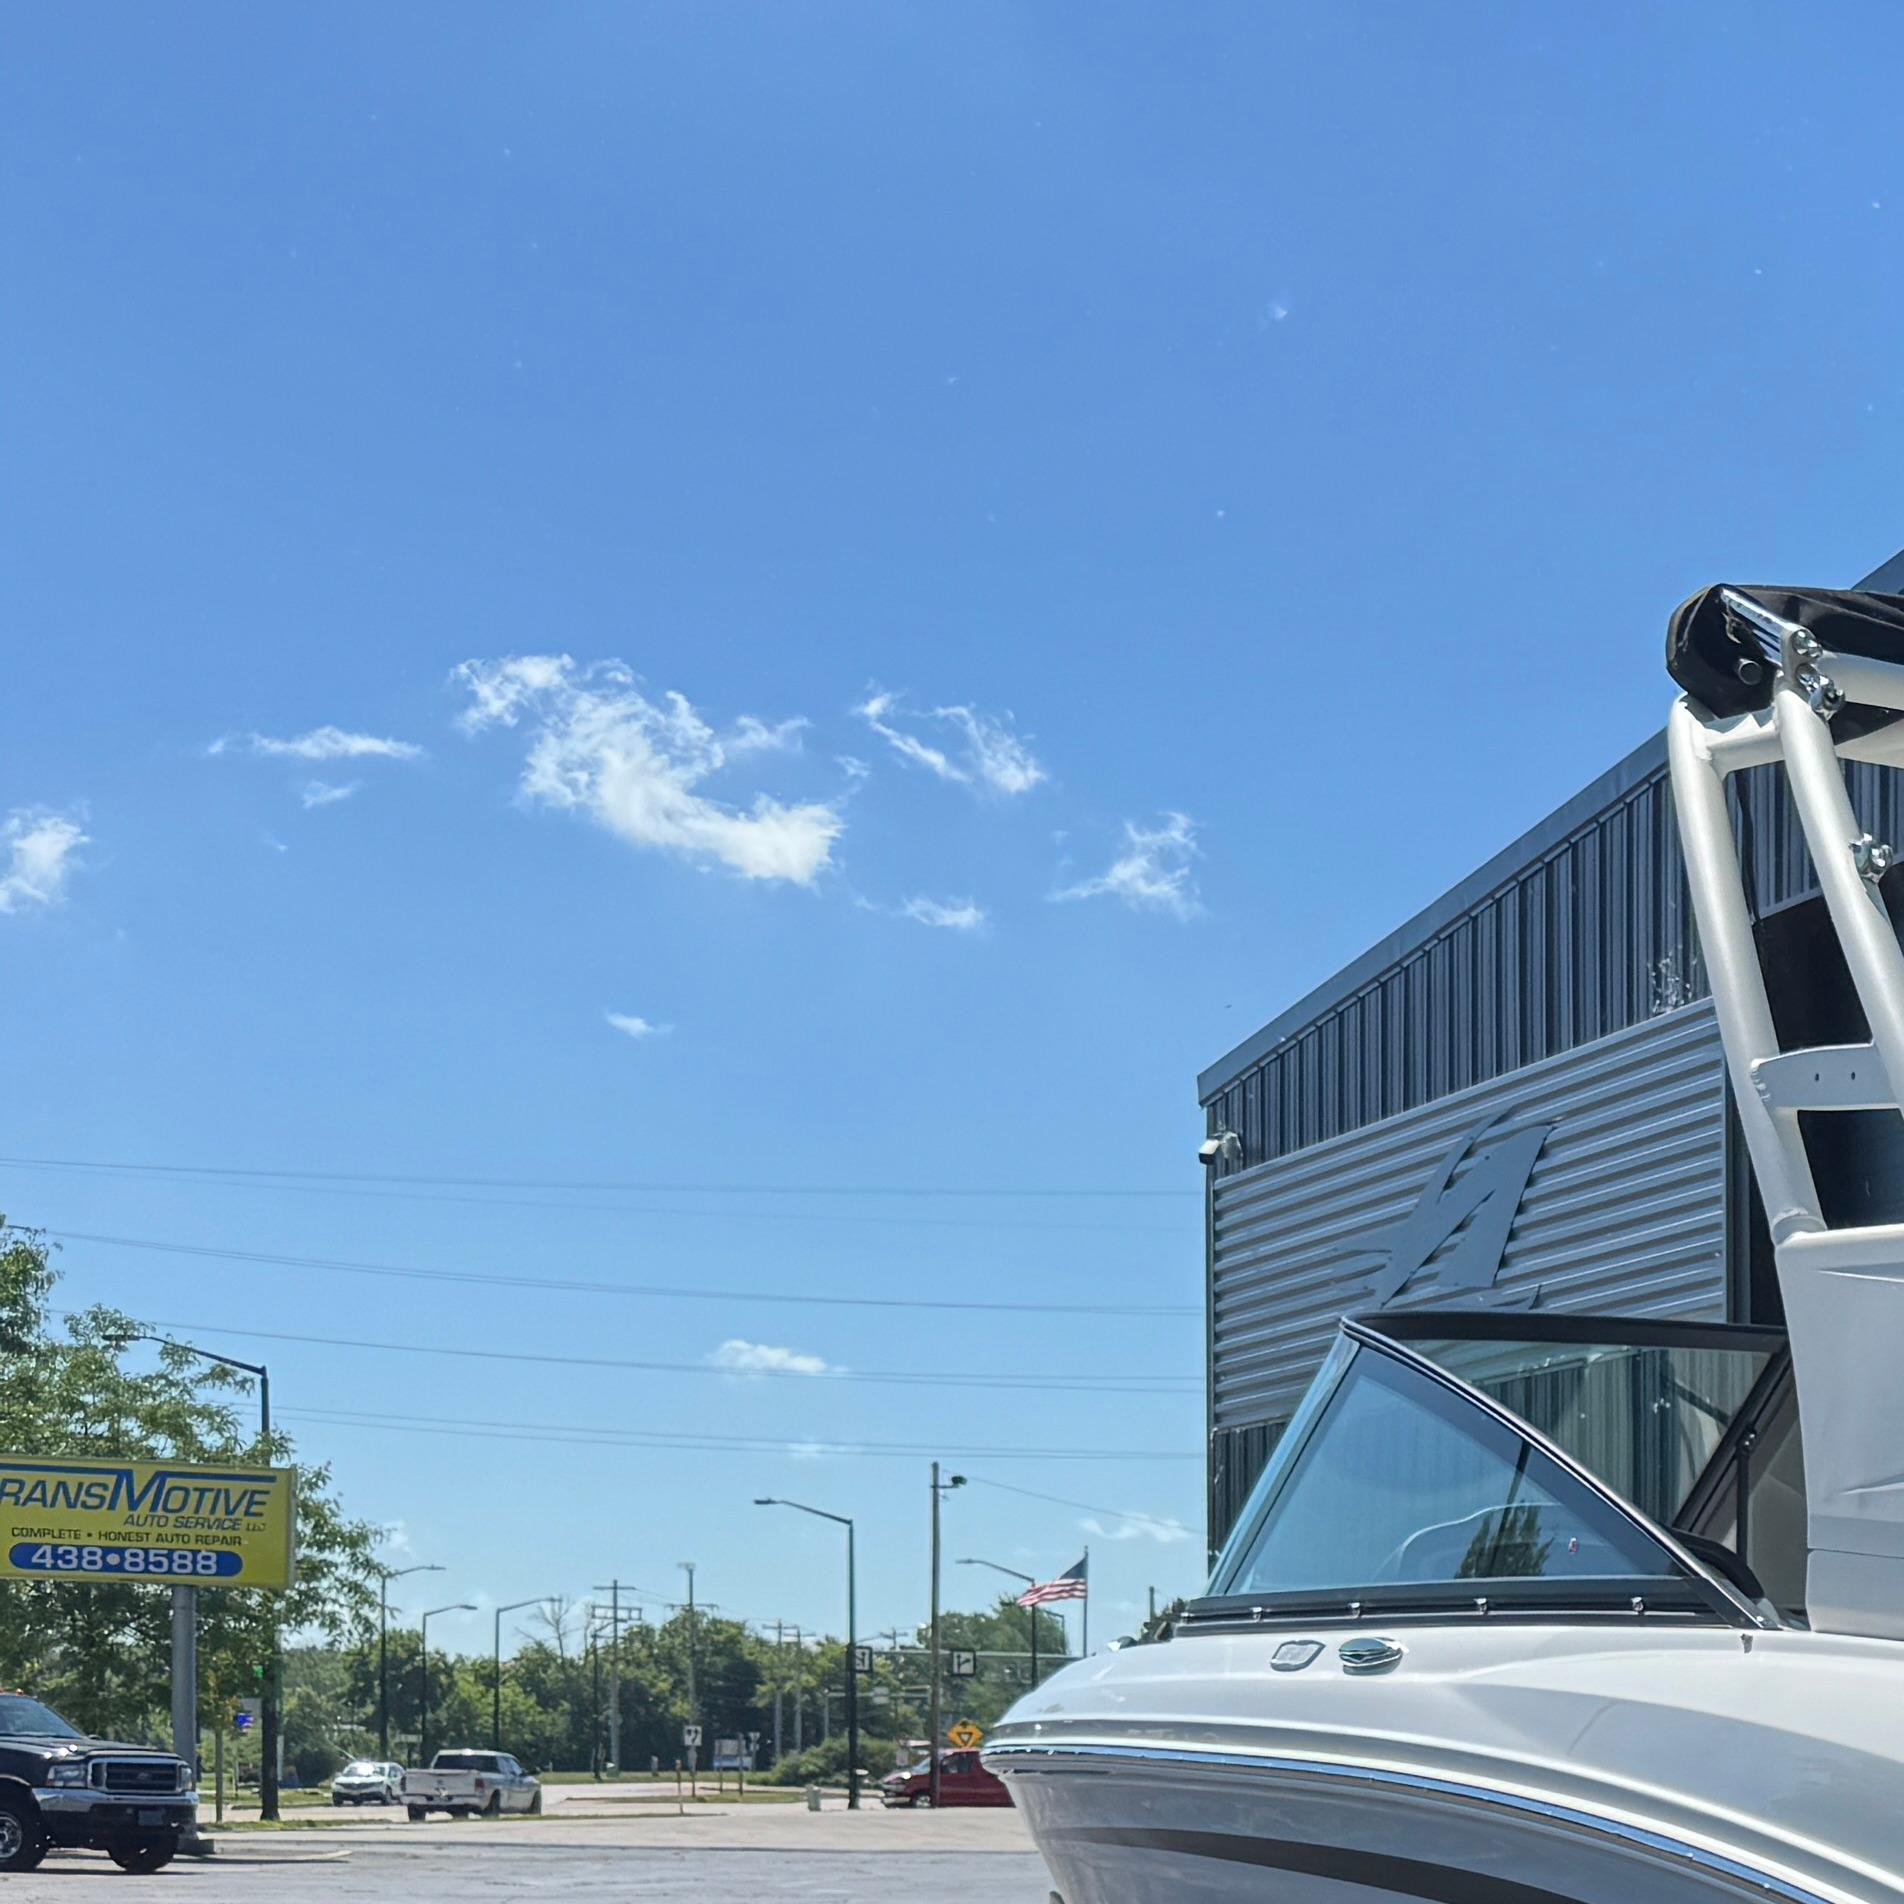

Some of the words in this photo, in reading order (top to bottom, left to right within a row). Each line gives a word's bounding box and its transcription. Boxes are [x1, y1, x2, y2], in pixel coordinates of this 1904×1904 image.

[0, 1465, 273, 1518] RANSMOTIVE
[123, 1514, 169, 1528] AUTO
[173, 1516, 243, 1532] SERVICE
[11, 1526, 81, 1540] COMPLETE
[98, 1531, 151, 1543] HONEST
[155, 1532, 190, 1544] AUTO
[195, 1534, 242, 1546] REPAIR
